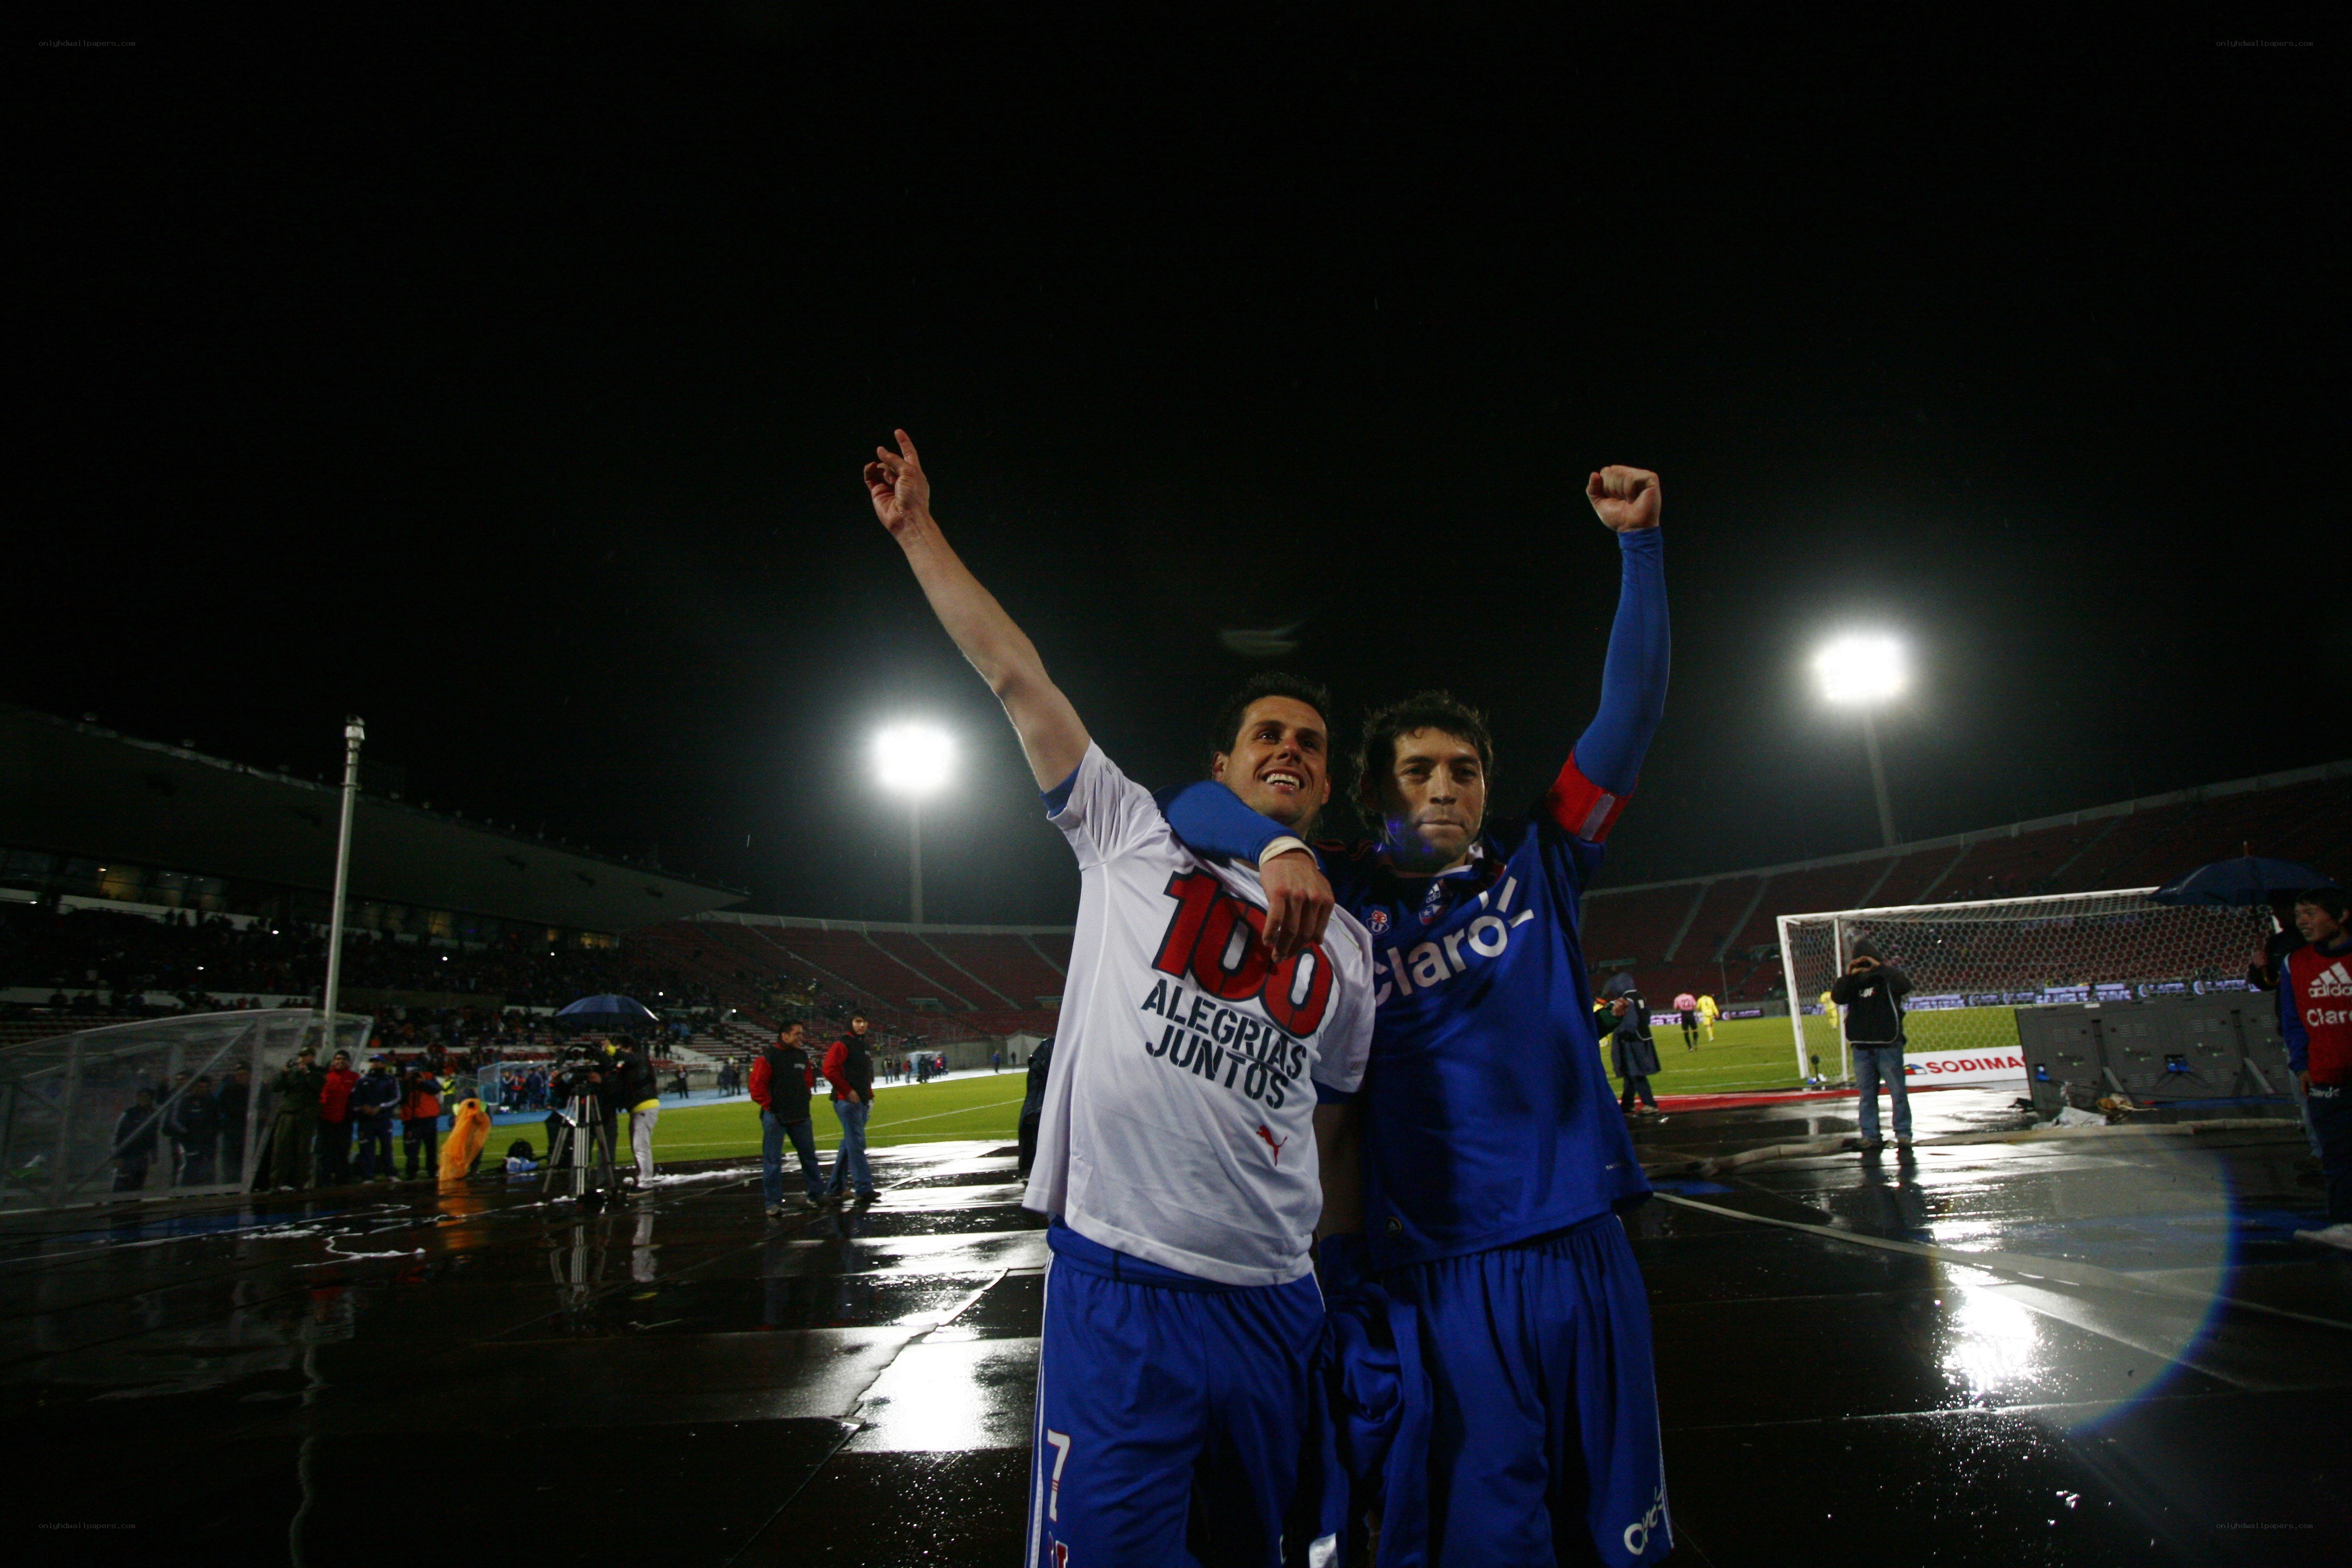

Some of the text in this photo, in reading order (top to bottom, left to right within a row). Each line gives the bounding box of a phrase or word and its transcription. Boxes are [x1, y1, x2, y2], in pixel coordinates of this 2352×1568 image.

[1151, 866, 1333, 1039] 100
[1140, 978, 1307, 1080] ALEGRIAS
[1146, 1025, 1289, 1109] JUNTOS
[1926, 1054, 2027, 1074] SODIMA
[1047, 1428, 1071, 1523] 7
